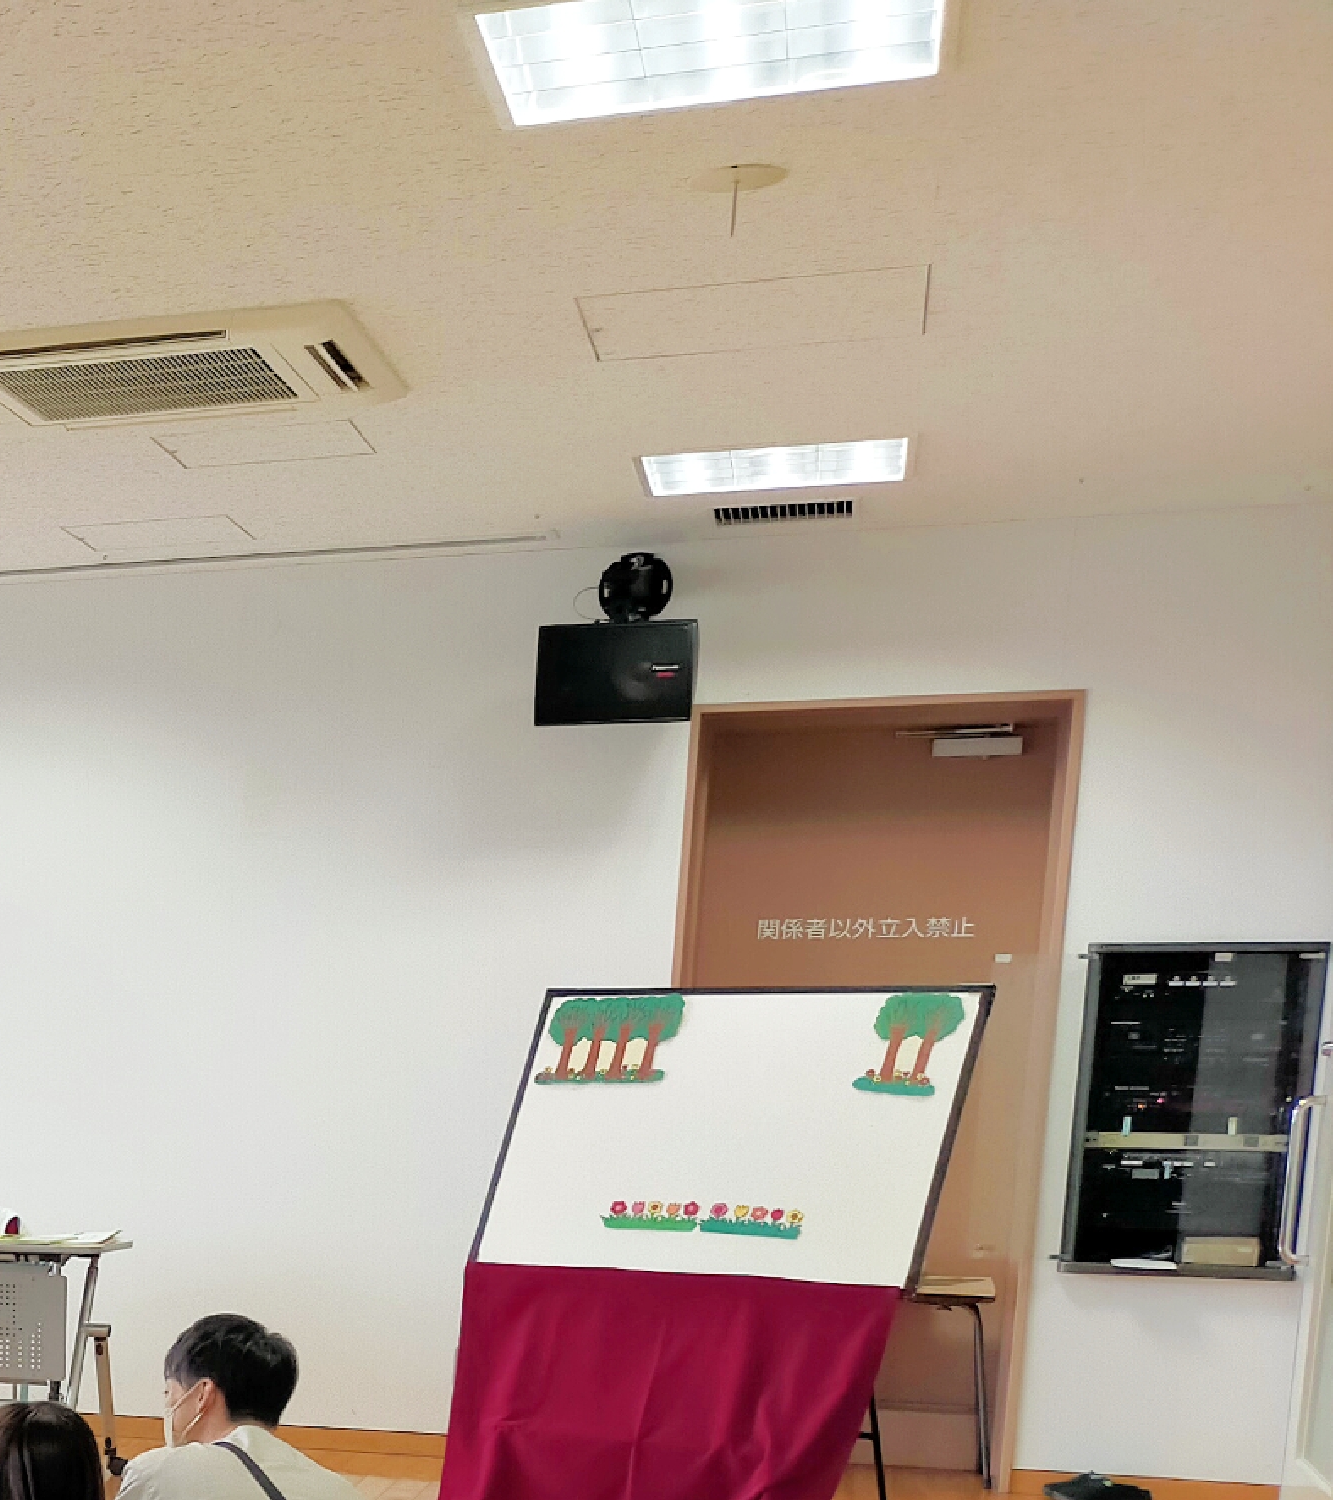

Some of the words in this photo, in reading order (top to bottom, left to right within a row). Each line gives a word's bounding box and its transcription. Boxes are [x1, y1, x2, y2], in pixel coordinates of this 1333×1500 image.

[757, 917, 975, 940] 関係者以外立入禁止
